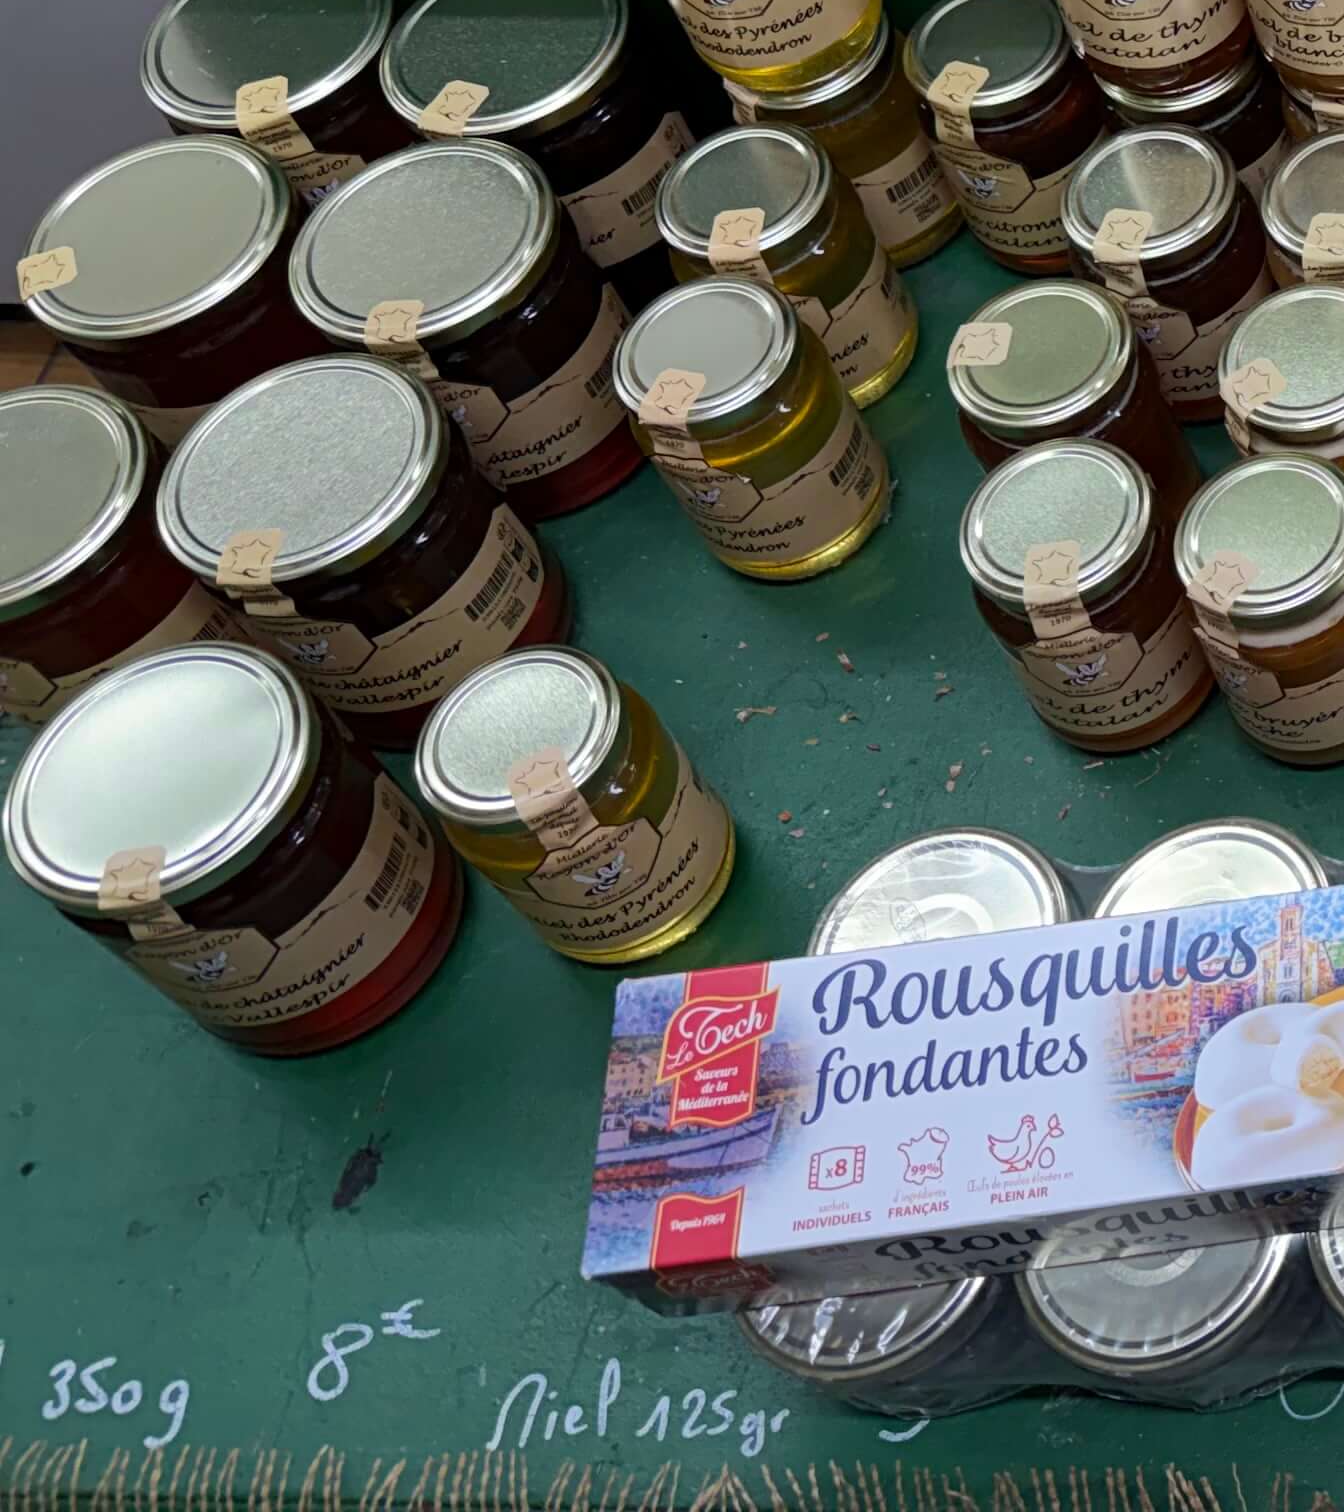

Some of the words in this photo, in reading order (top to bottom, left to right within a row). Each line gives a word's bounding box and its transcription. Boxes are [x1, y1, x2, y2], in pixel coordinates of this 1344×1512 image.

[811, 914, 1259, 1037] Rousquilles
[677, 1004, 768, 1052] Tech
[665, 1042, 697, 1071] Le
[693, 1063, 739, 1083] Saveurs
[799, 1020, 1089, 1126] fondantes
[677, 1090, 750, 1113] Méditerranée
[910, 1161, 940, 1179] 99%
[990, 1189, 1025, 1205] PLEIN
[1027, 1186, 1050, 1199] AIR
[792, 1208, 873, 1234] INDIVIDUELS
[887, 1198, 950, 1221] FRANÇAIS
